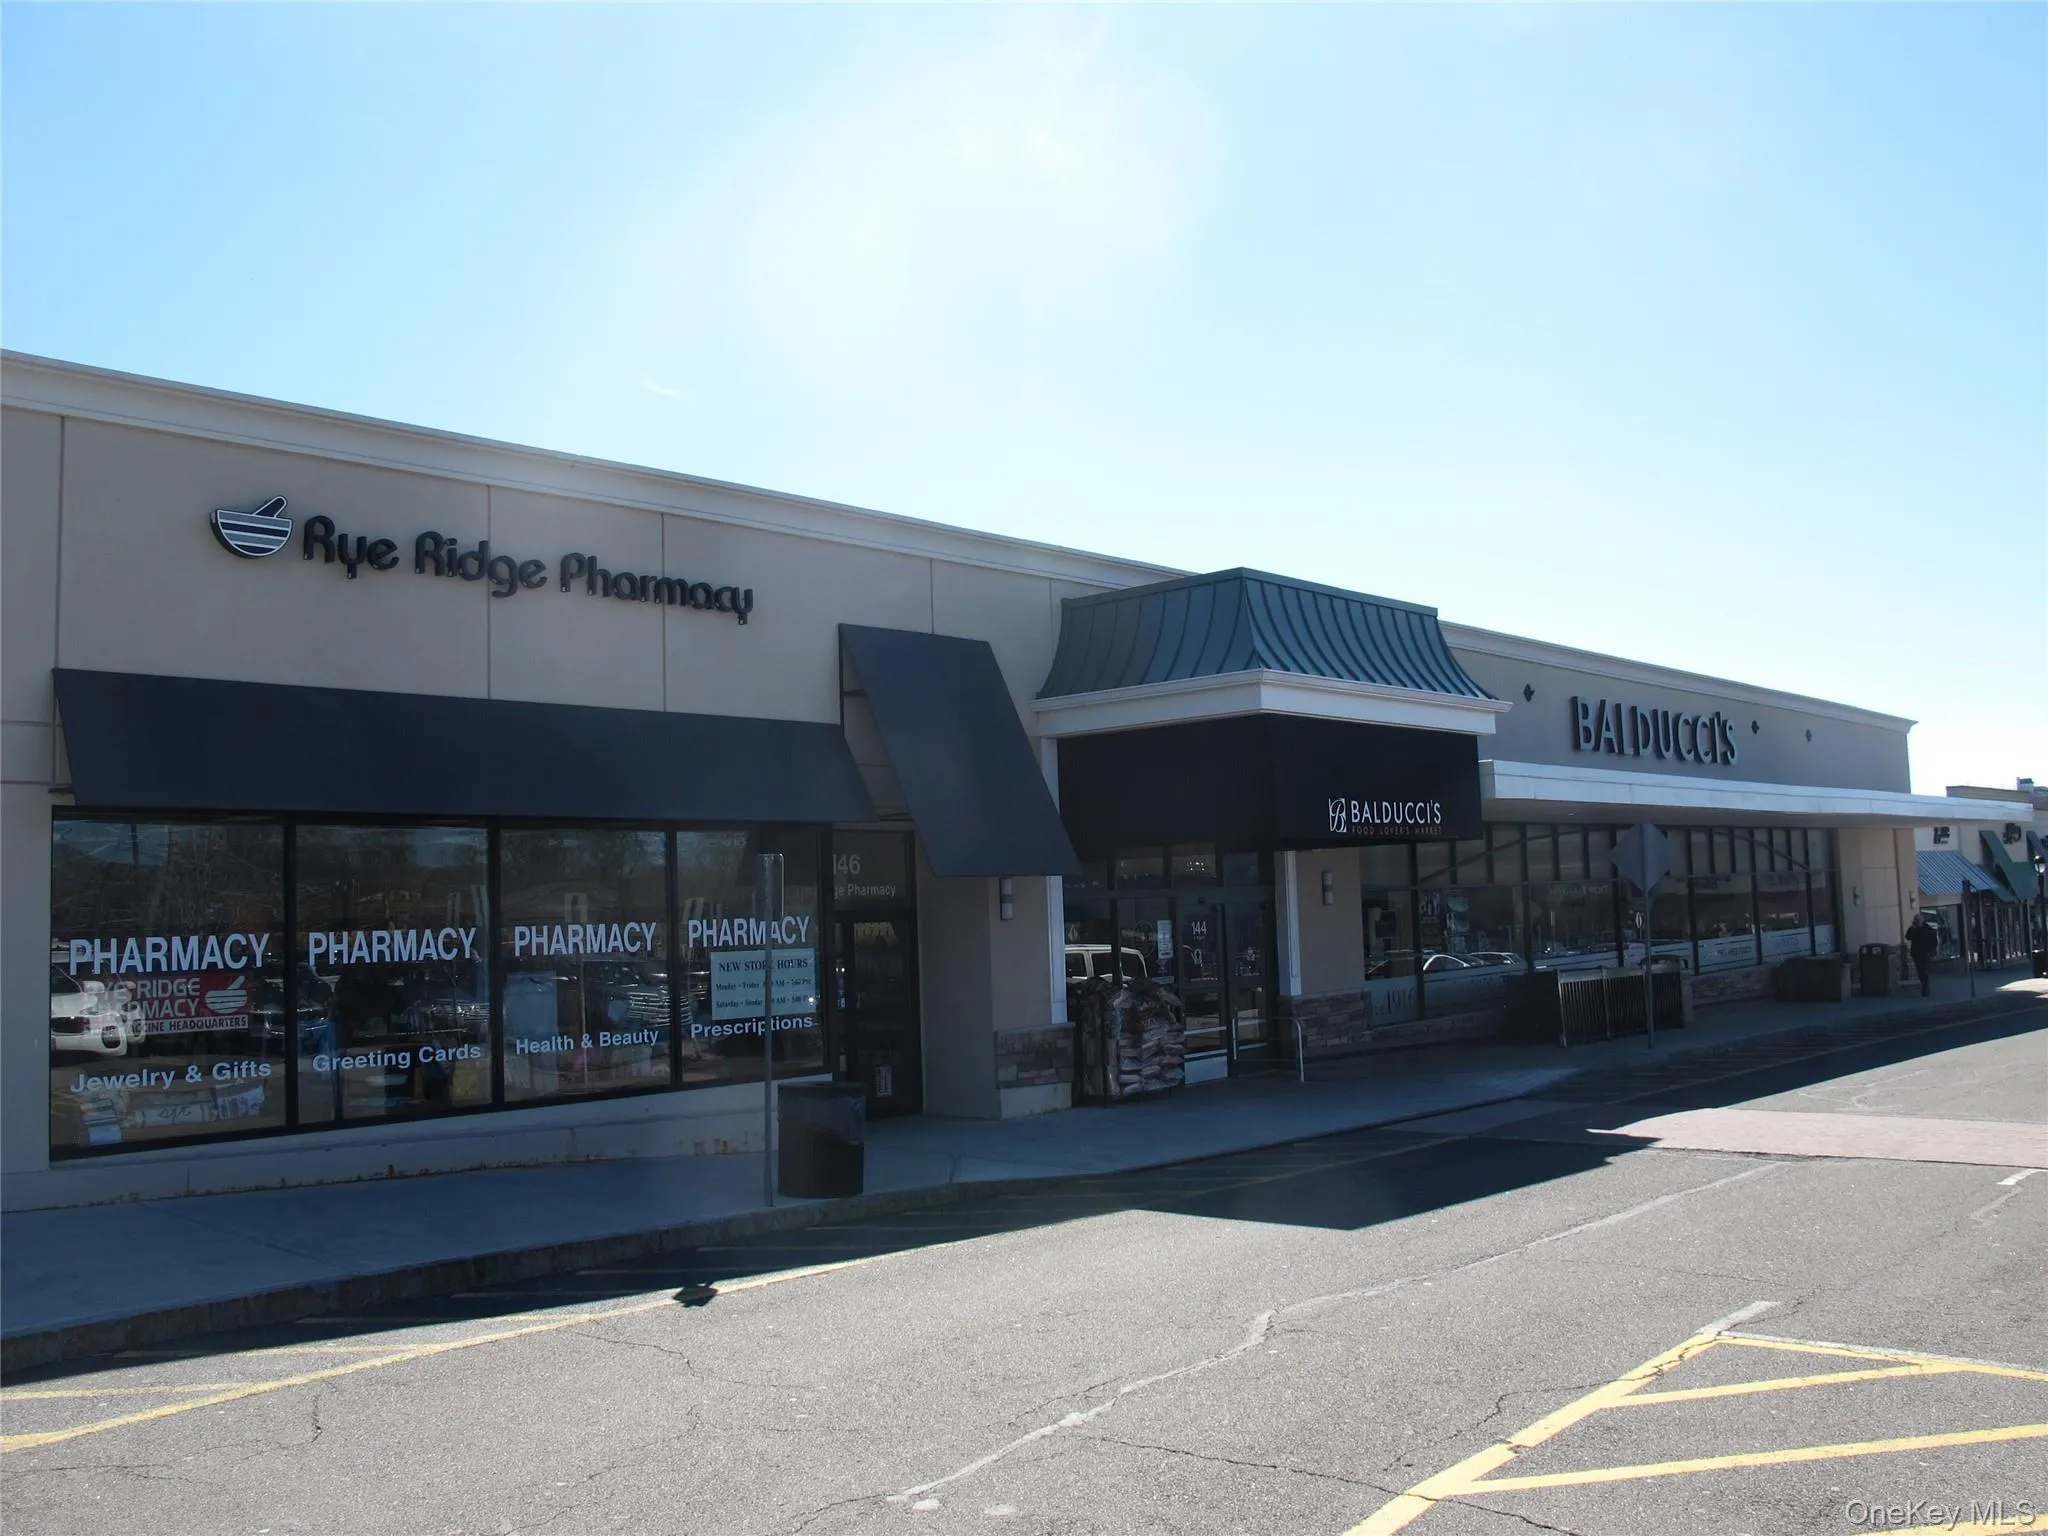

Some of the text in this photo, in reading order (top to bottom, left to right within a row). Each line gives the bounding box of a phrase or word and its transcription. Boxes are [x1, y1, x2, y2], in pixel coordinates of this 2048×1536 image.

[303, 514, 754, 625] Rye Ridge Pharmacy
[1570, 696, 1738, 767] BALDUCCI'S
[1350, 800, 1442, 825] BALDUCCI'S
[1351, 825, 1375, 836] FOOD
[1415, 825, 1442, 836] MARKET
[847, 884, 896, 899] Pharmacy
[514, 921, 657, 957] PHARMACY
[687, 915, 810, 948] PHARMACY
[1191, 920, 1208, 935] 144
[69, 932, 272, 976] PHARMACY
[308, 927, 477, 966] PHARMACY
[719, 958, 808, 973] NEW STO HOURS
[136, 977, 200, 999] RIDGE
[124, 1020, 165, 1035] ACCINE
[169, 1016, 247, 1031] HEADQUARTERS
[690, 1015, 814, 1040] Prescriptions
[516, 1029, 659, 1055] Health & Beauty
[312, 1043, 481, 1073] Greeting Cards
[70, 1060, 272, 1094] Jewelry & Gifts
